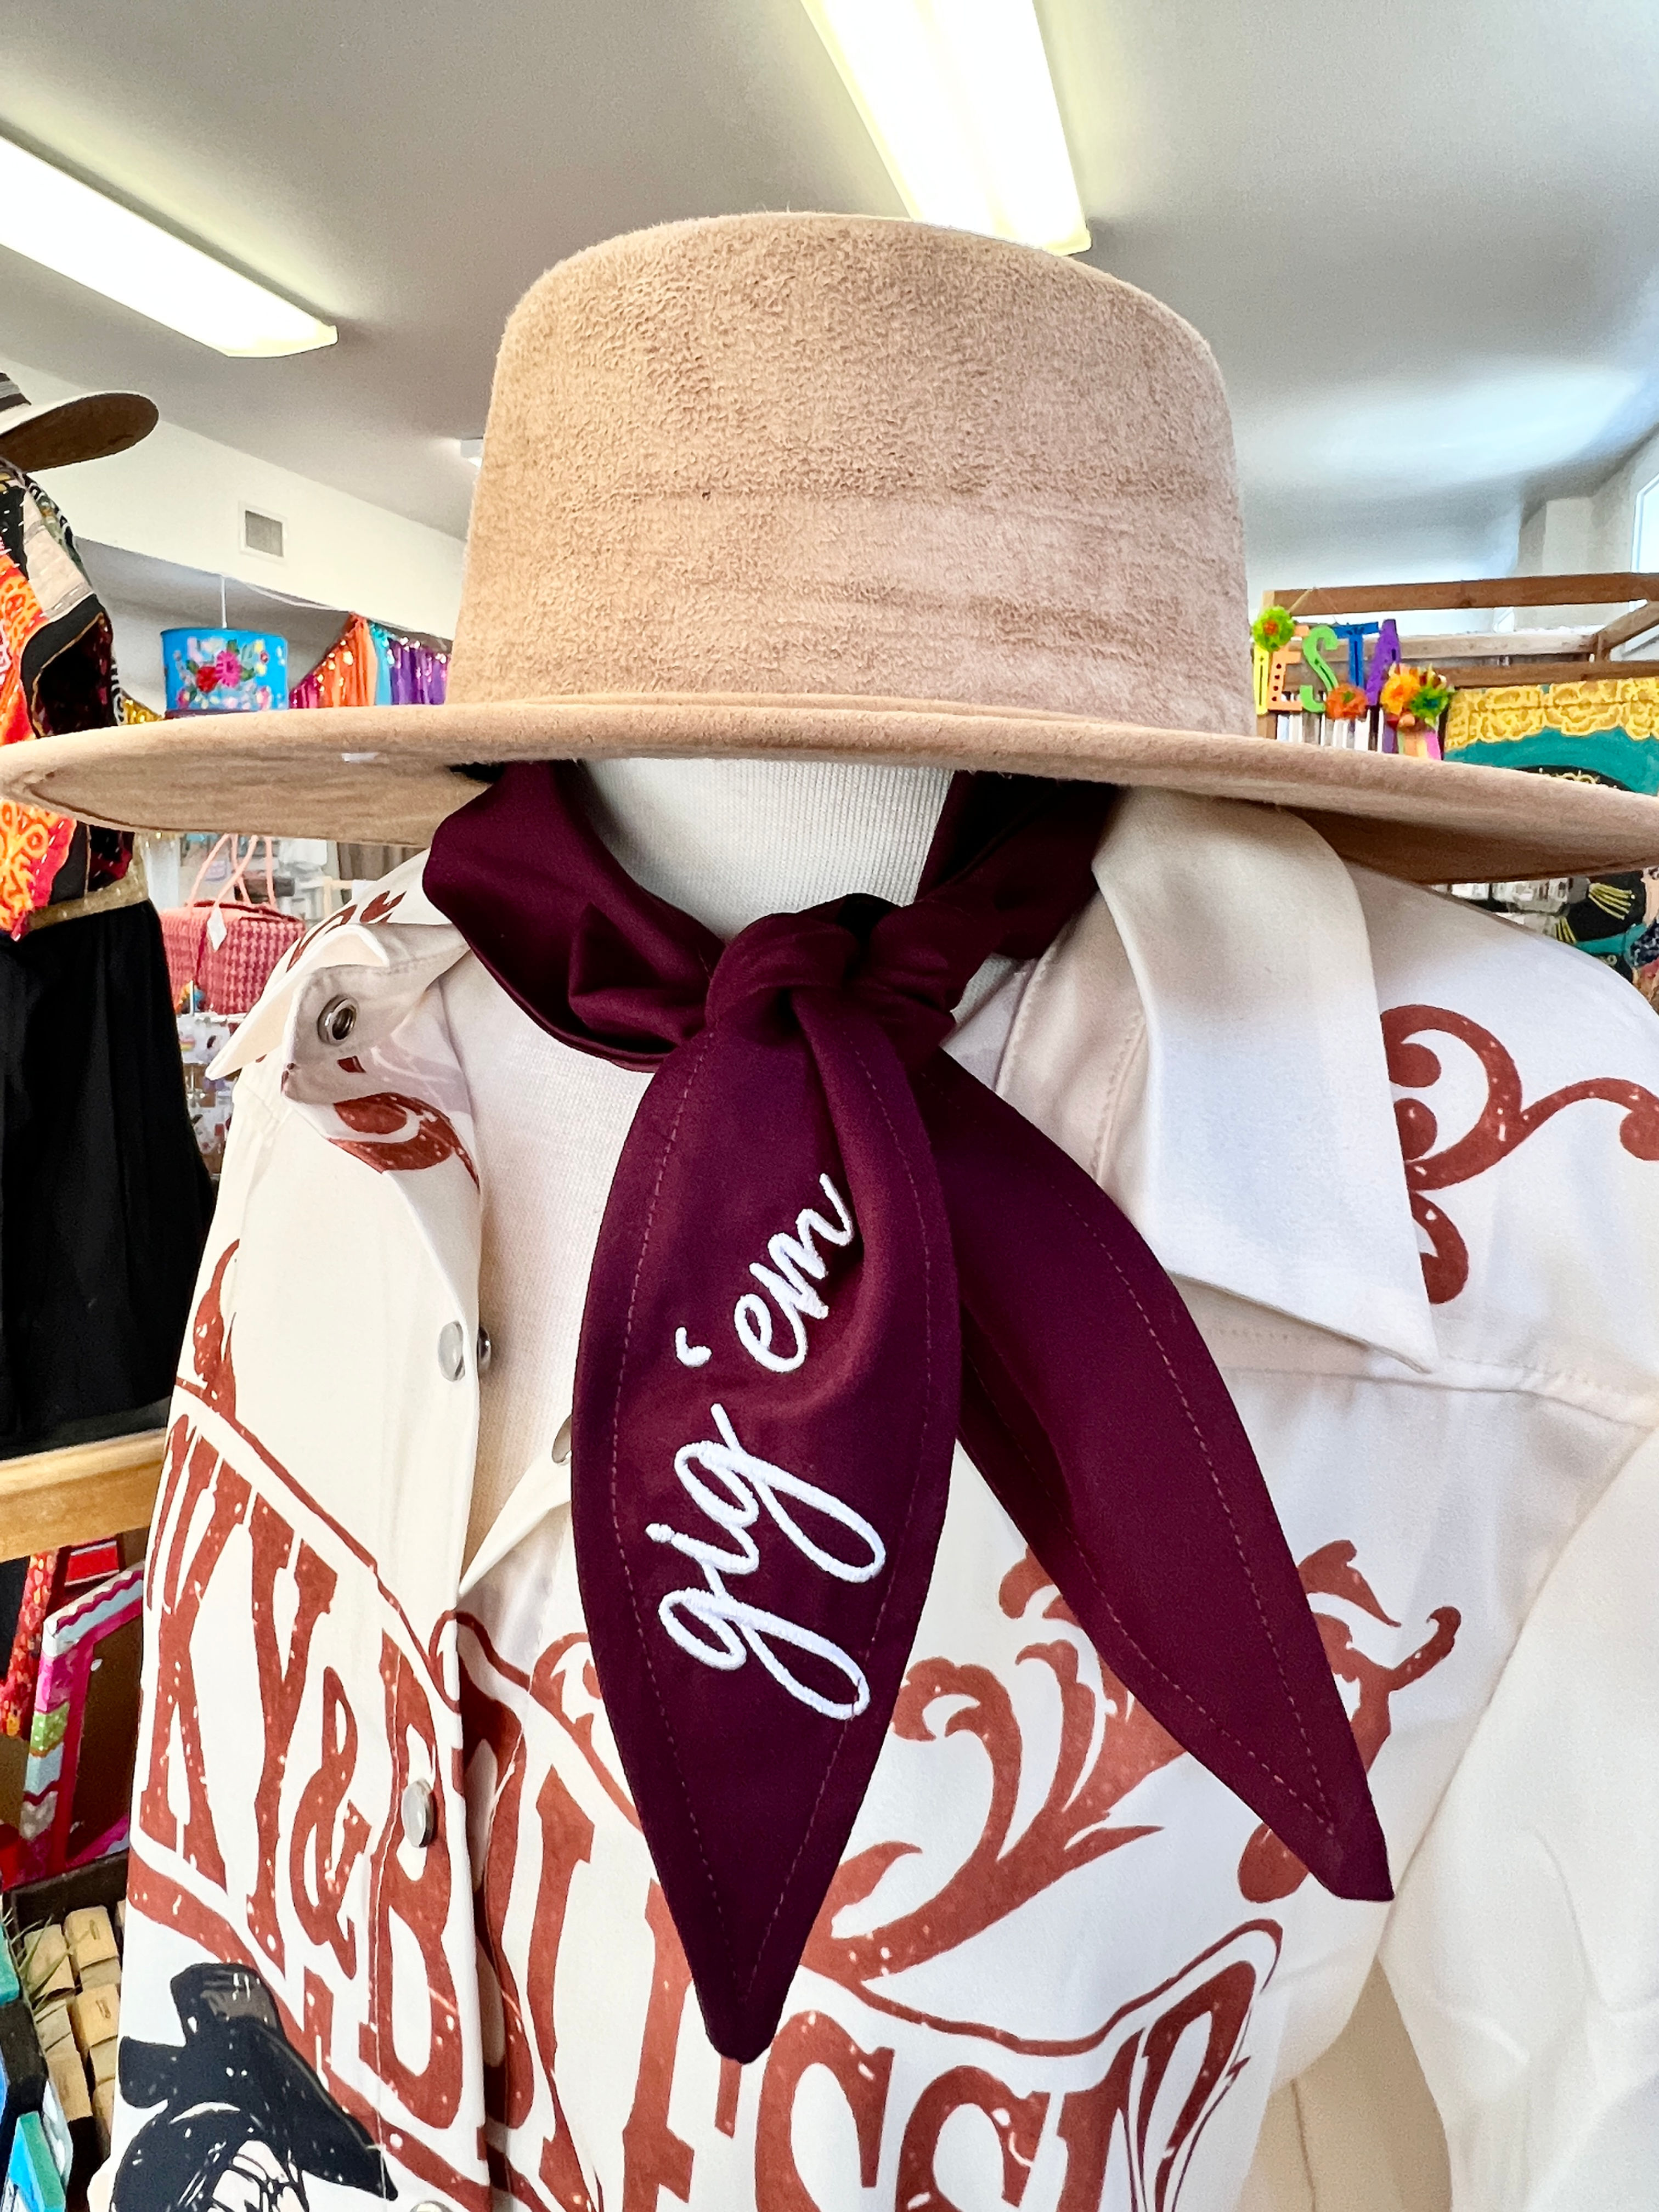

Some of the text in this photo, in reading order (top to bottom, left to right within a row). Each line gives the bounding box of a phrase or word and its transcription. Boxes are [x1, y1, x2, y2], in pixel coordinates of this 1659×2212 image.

[139, 1413, 338, 1976] KY
[289, 1665, 373, 1980] &
[645, 1403, 887, 1721] gig
